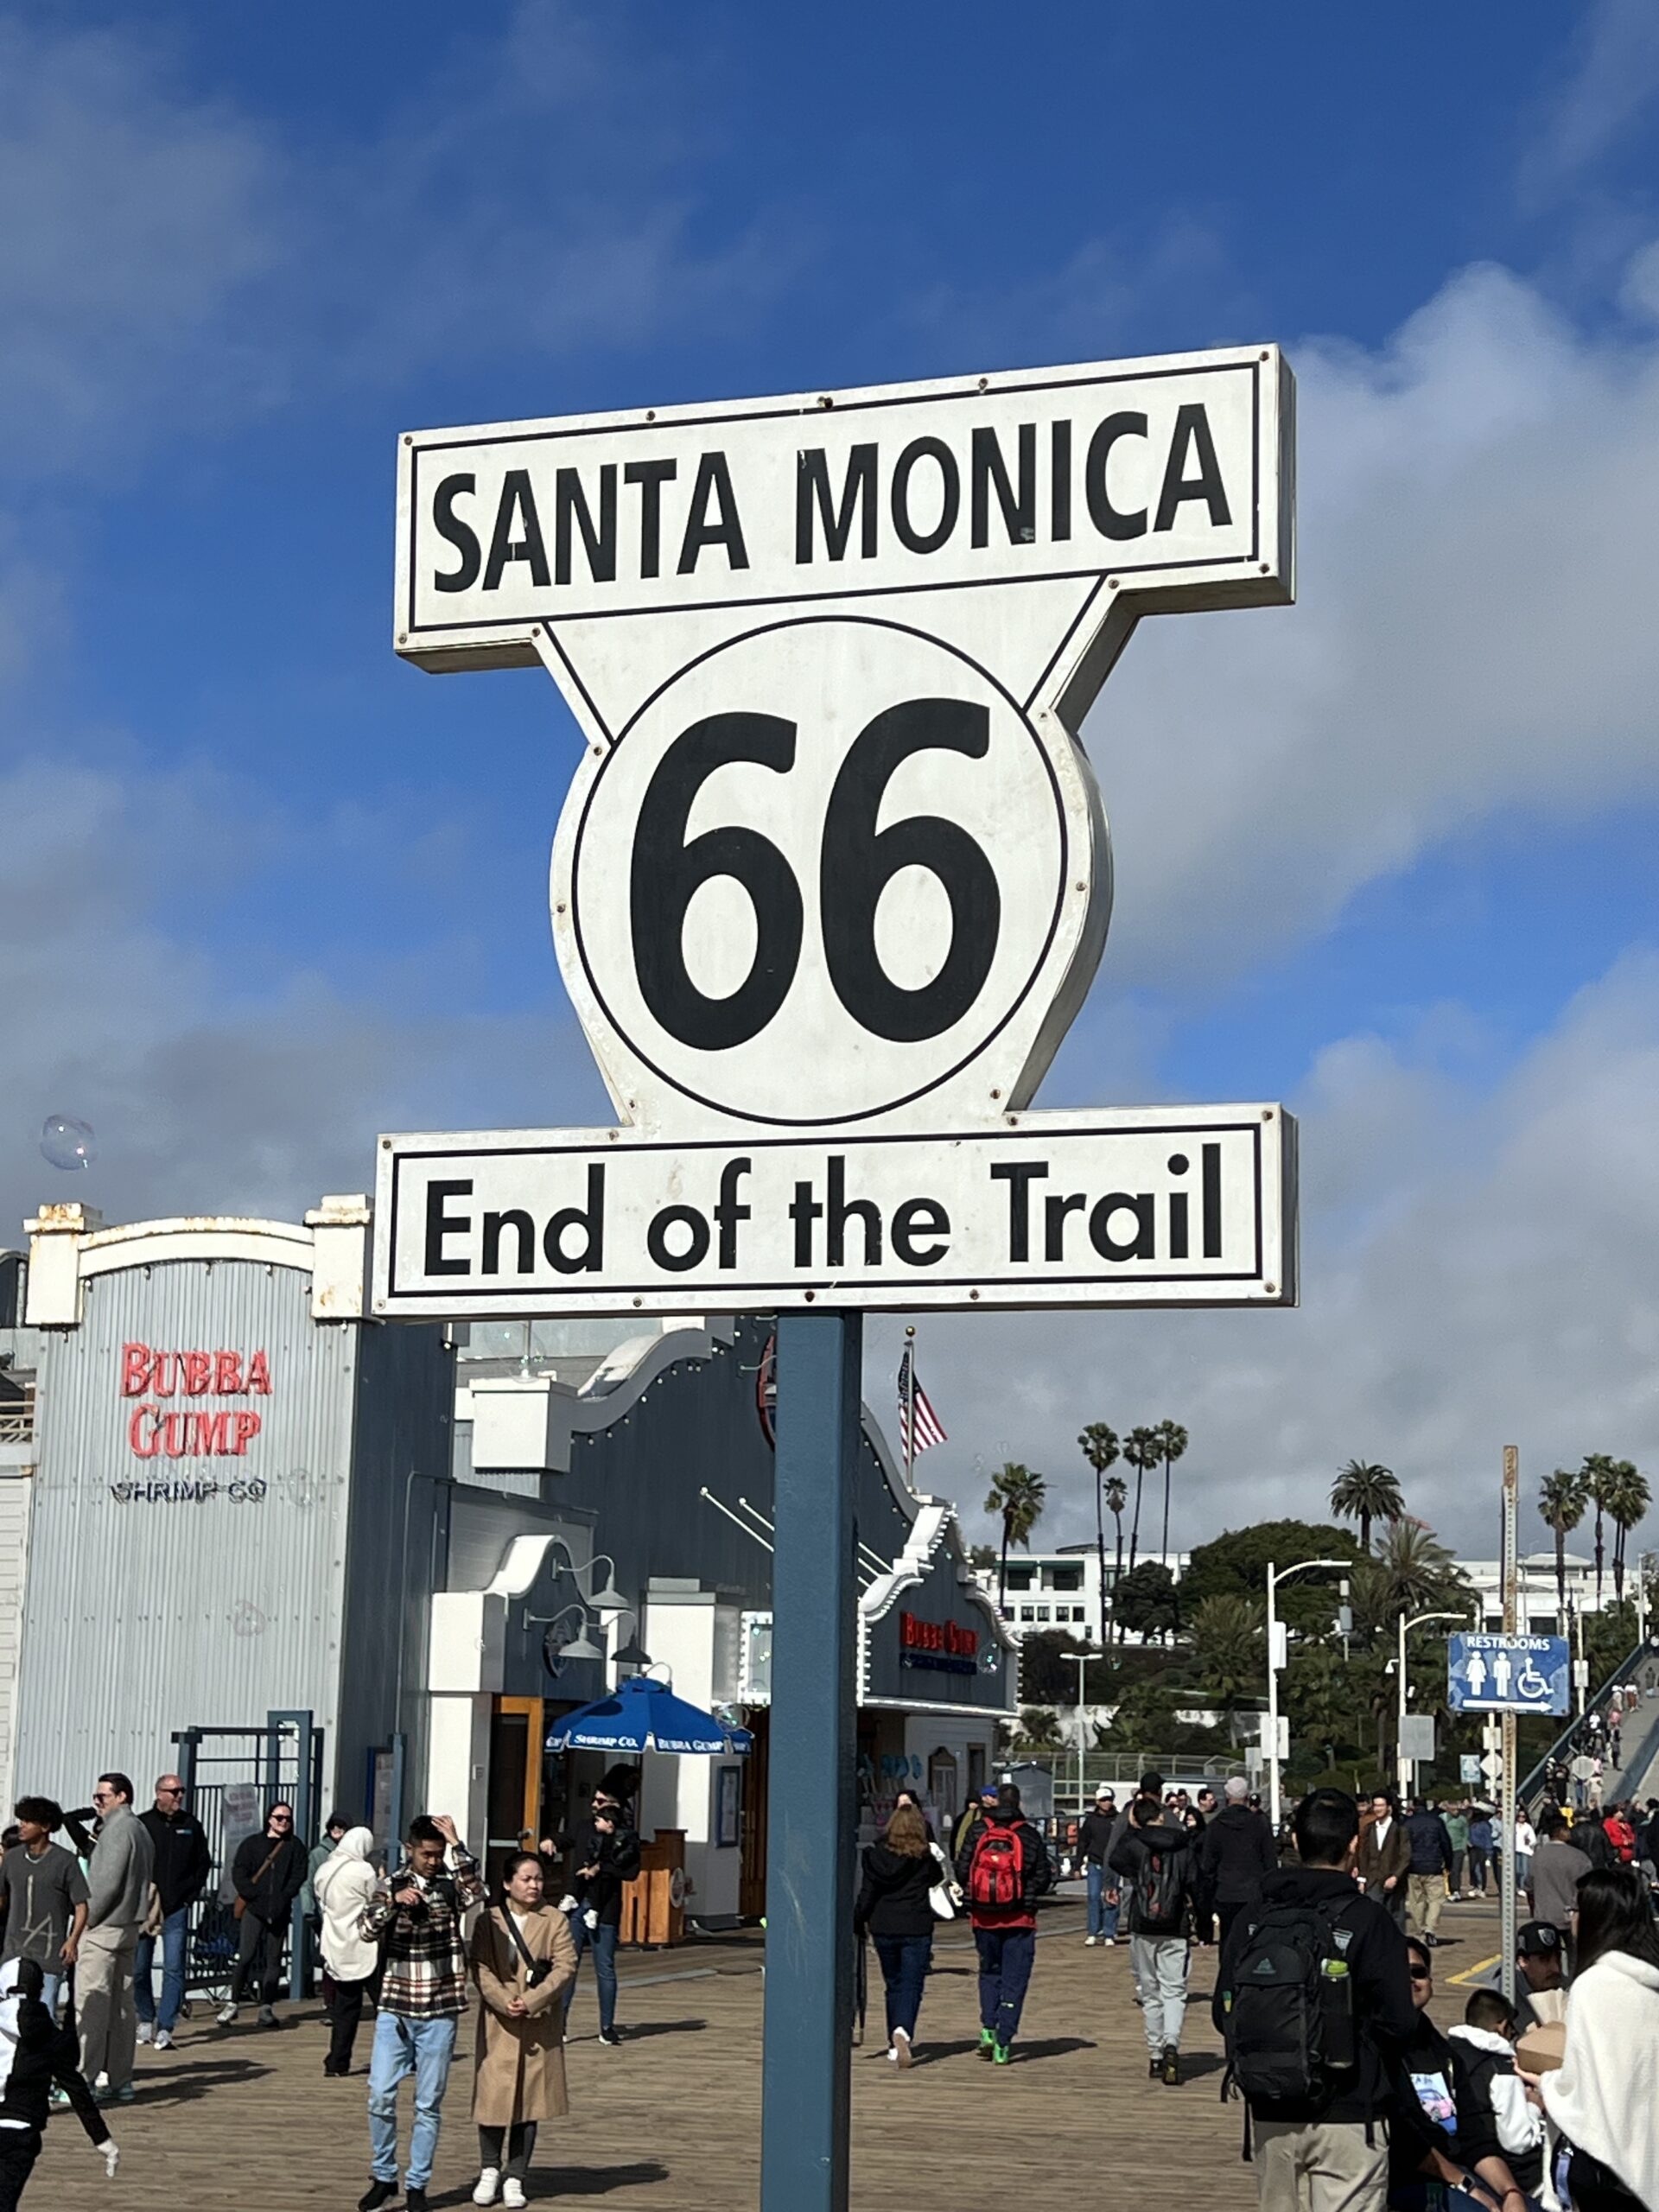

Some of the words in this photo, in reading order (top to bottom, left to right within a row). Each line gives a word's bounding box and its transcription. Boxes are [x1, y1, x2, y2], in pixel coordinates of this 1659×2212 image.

[432, 451, 750, 593] SANTA
[795, 403, 1234, 565] MONICA
[630, 697, 1001, 1052] 66
[423, 1163, 605, 1276] End
[647, 1157, 752, 1272] of
[788, 1155, 950, 1268] the
[990, 1143, 1222, 1262] Trail
[120, 1342, 272, 1398] BUBBA
[129, 1402, 261, 1459] GUMP
[111, 1479, 218, 1504] SHRIMP
[1466, 1635, 1551, 1651] RESTROOMS
[618, 1735, 639, 1748] CO.
[658, 1738, 692, 1751] BUBBA
